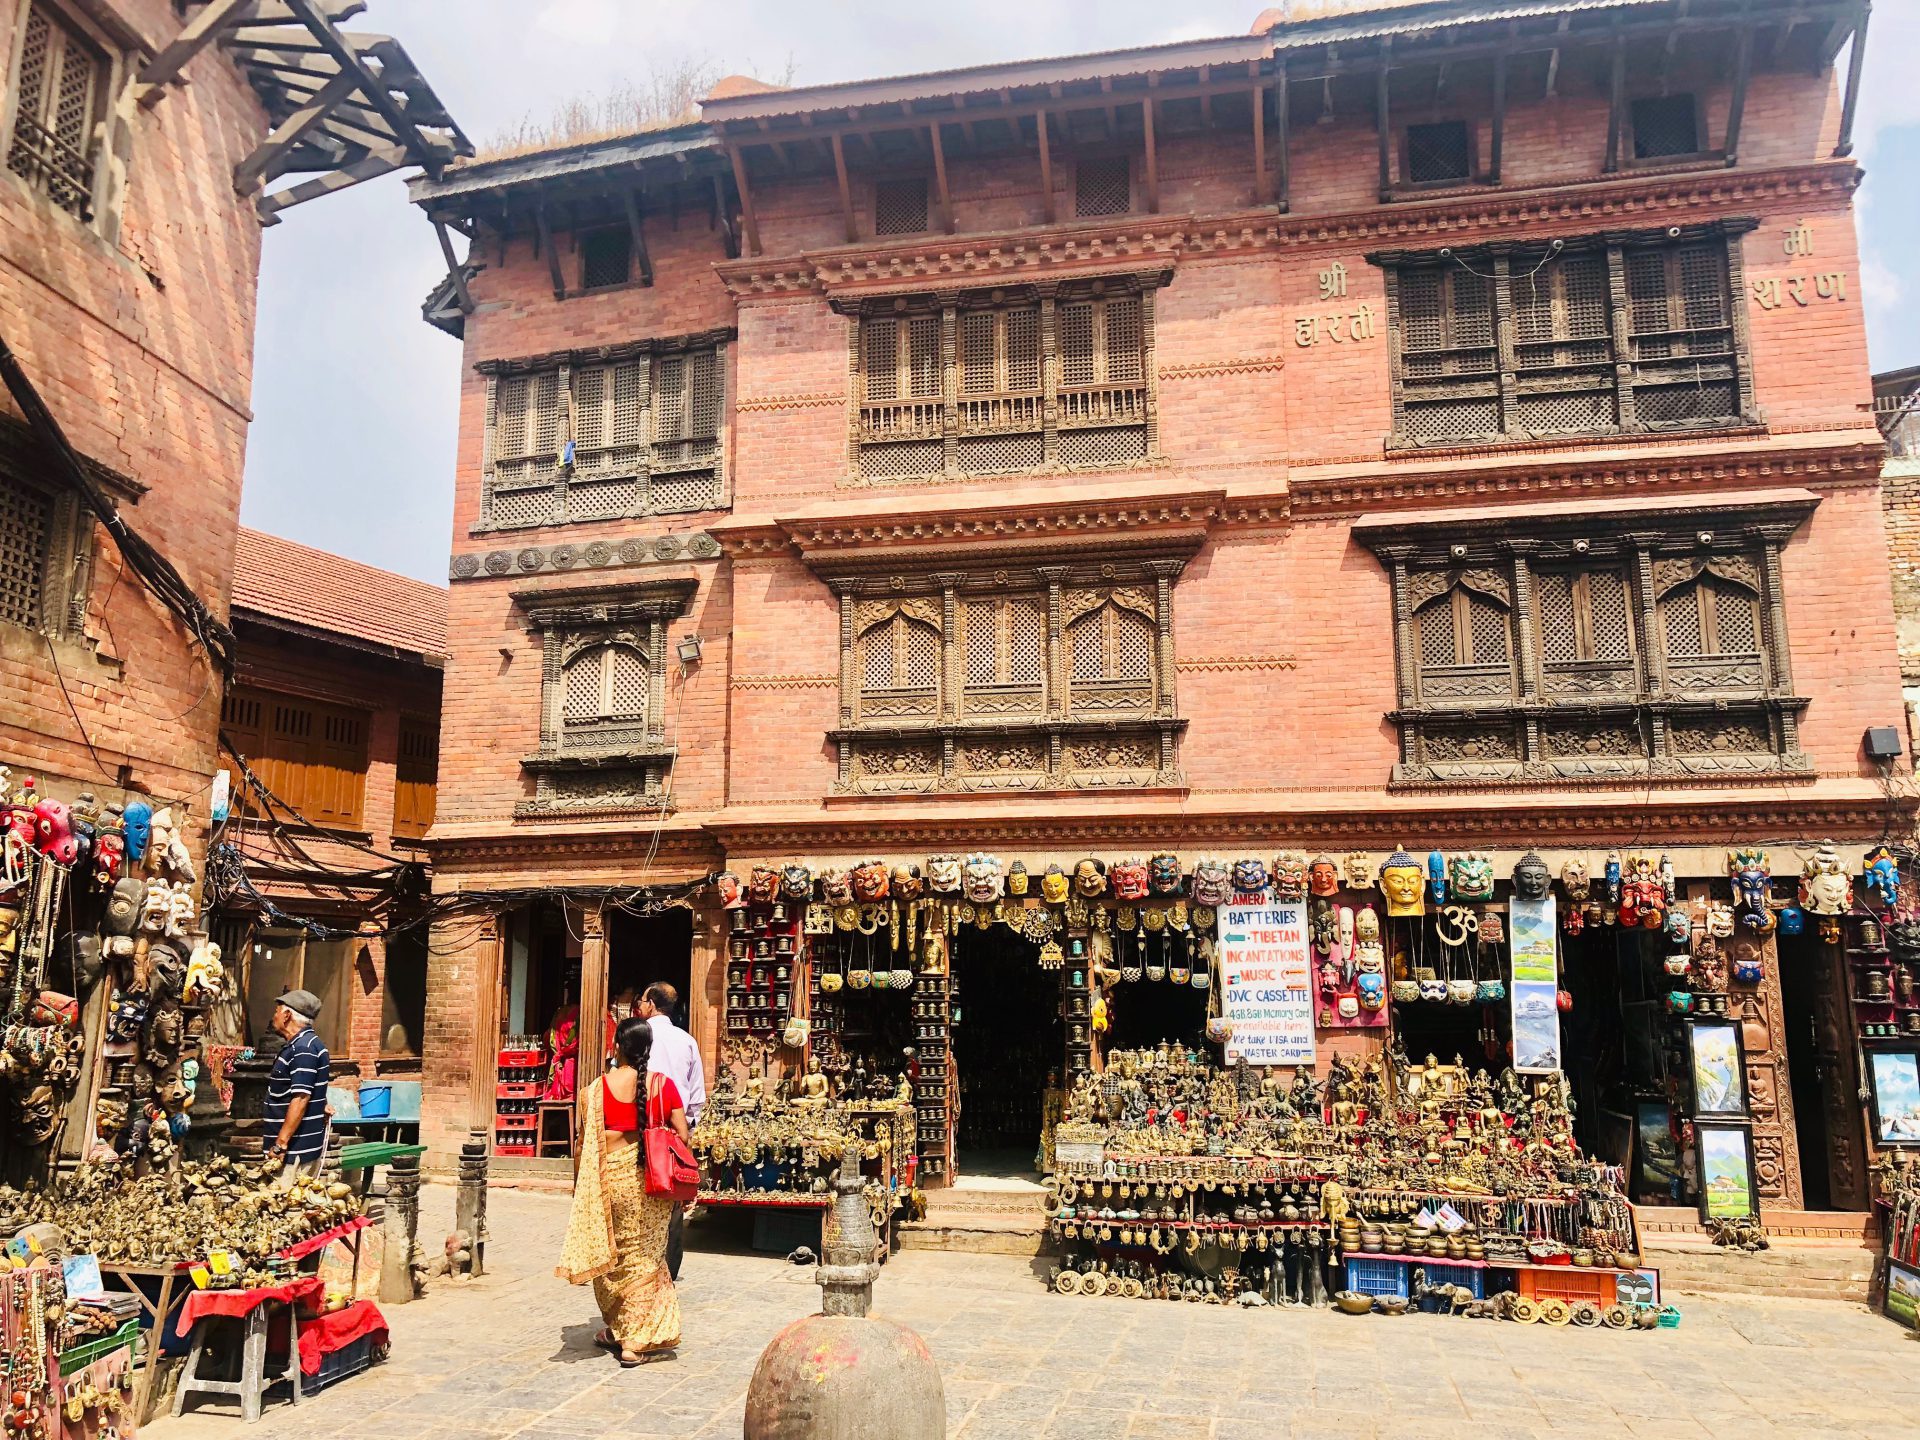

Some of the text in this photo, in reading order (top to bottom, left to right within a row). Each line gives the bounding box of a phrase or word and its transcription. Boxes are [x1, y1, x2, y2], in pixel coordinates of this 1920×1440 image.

[1318, 261, 1348, 300] श्री
[1752, 272, 1846, 310] शरण
[1295, 304, 1375, 347] हारती
[1229, 911, 1297, 925] BATTERIES
[1250, 930, 1300, 943] TIBETAN
[1226, 949, 1305, 963] INCANTATIONS
[1240, 969, 1276, 981] MUSIC
[1256, 989, 1309, 1002] CASSETTE
[1233, 1034, 1308, 1045] We take VISA and
[1244, 1047, 1301, 1058] MASTER CARD
